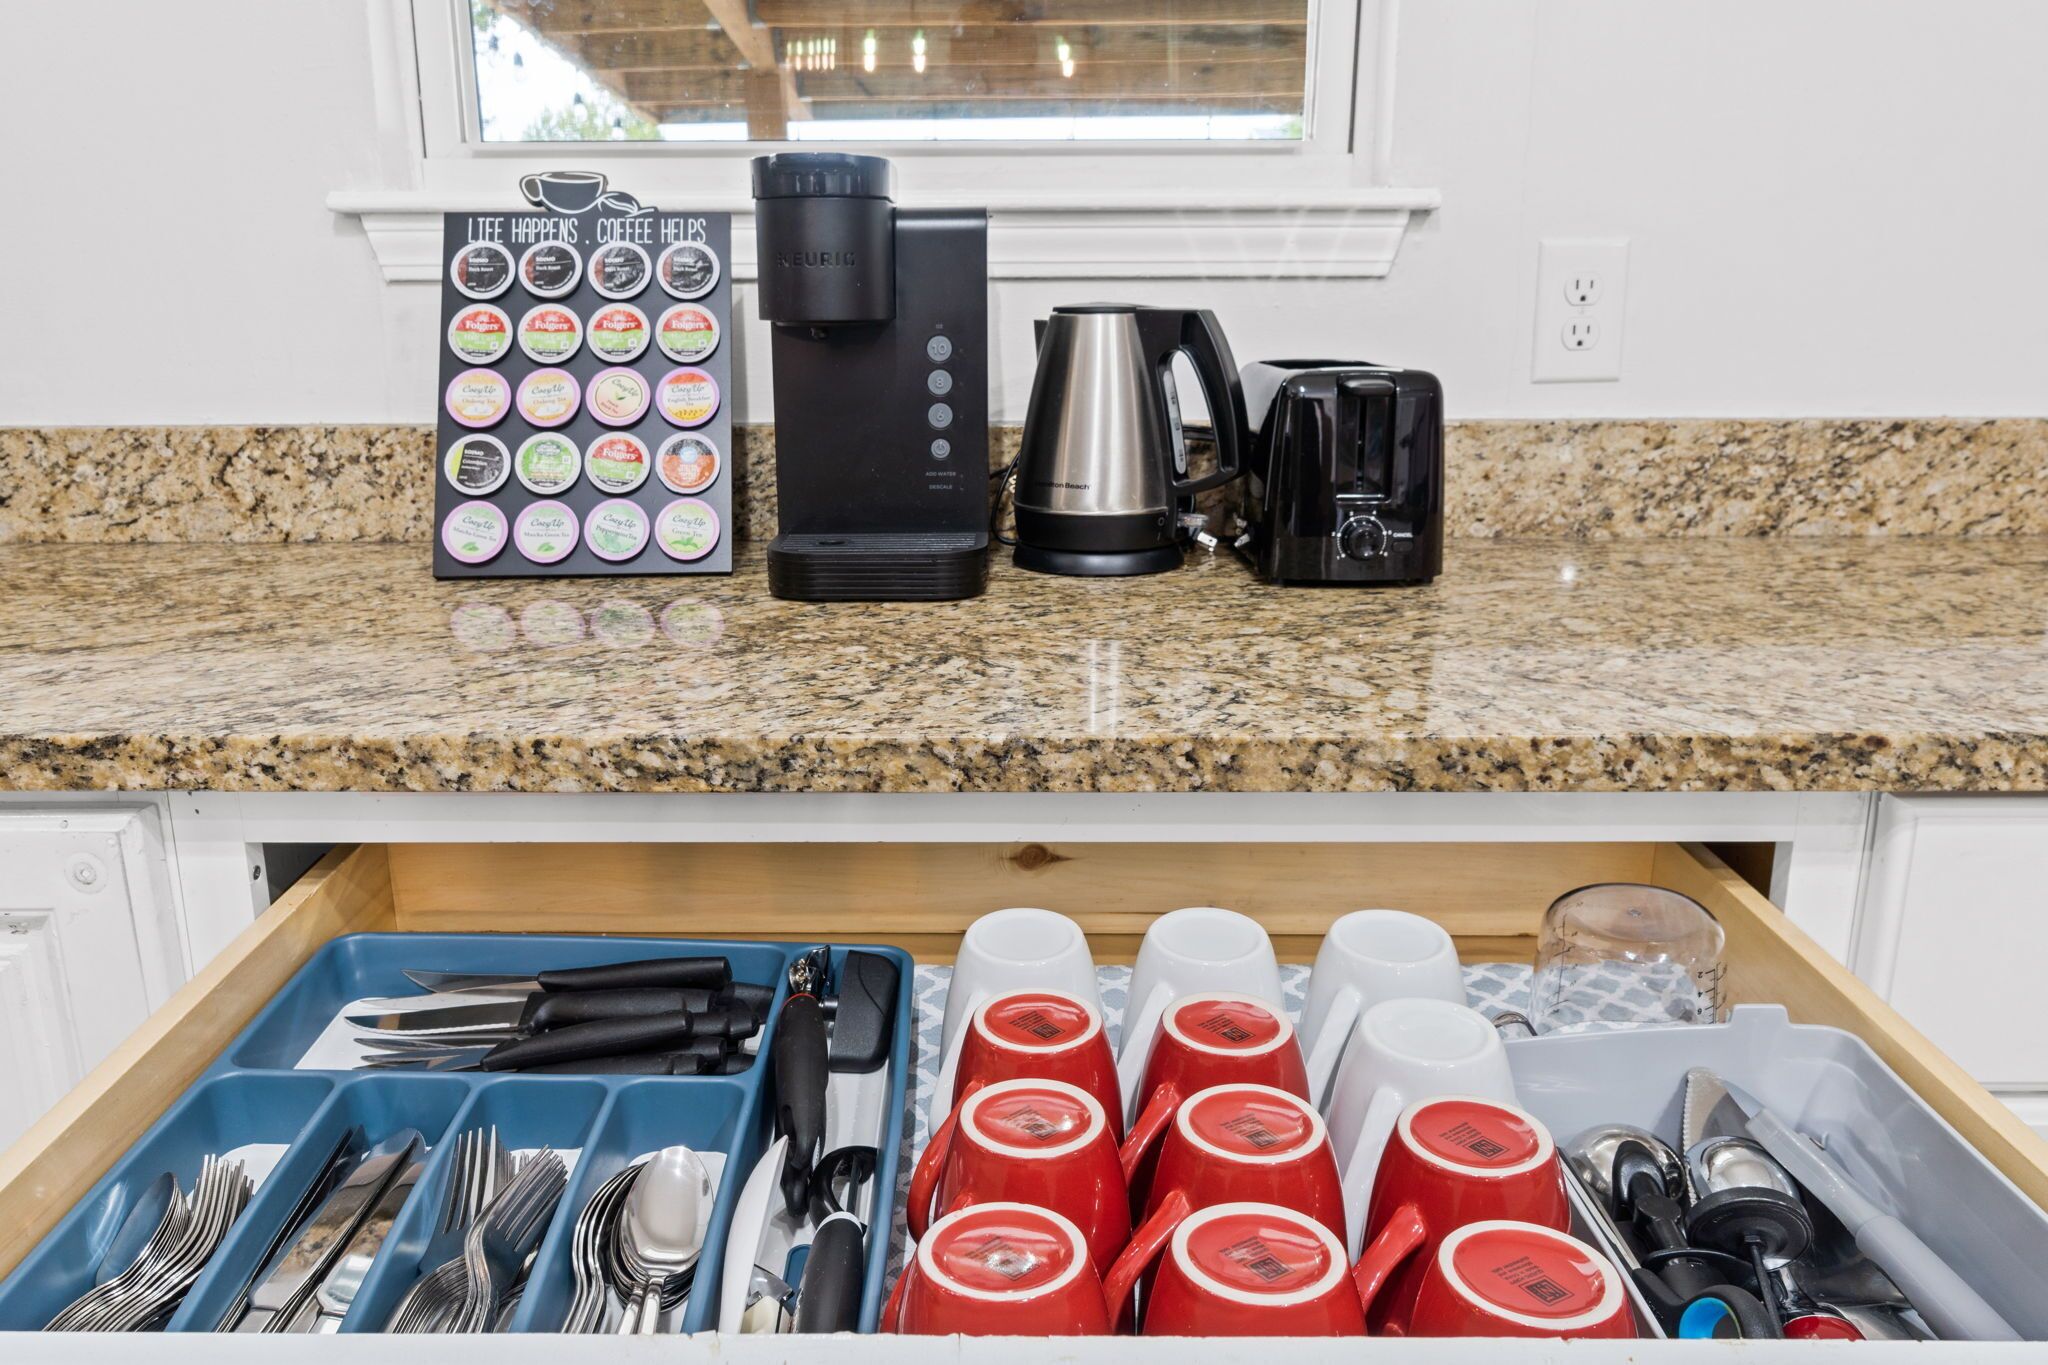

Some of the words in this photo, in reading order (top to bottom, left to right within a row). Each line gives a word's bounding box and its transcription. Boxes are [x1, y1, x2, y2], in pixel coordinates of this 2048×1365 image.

[466, 217, 505, 243] LIFE
[511, 217, 578, 243] HAPPENS
[597, 217, 653, 244] COFFEE
[661, 217, 707, 244] HELPS
[777, 252, 855, 269] KEURIG
[465, 320, 498, 331] Folgers
[534, 320, 568, 331] Folgers
[603, 320, 635, 330] Folgers
[672, 320, 705, 330] Folgers
[932, 343, 947, 355] 10
[936, 377, 944, 388] 8
[462, 384, 483, 394] Cozy
[483, 384, 496, 393] Up
[531, 386, 552, 395] Cozy
[551, 384, 565, 393] Up
[671, 385, 692, 394] Cozy
[692, 384, 705, 393] Up
[936, 410, 944, 421] 6
[603, 448, 635, 460] Folgers
[1065, 482, 1090, 490] Beach
[462, 516, 484, 528] Cozy
[483, 520, 496, 530] Up
[531, 518, 551, 528] Cozy
[551, 518, 564, 528] Up
[603, 514, 624, 525] Cozy
[624, 519, 636, 528] Up
[672, 514, 693, 526] Cozy
[692, 517, 706, 527] Up
